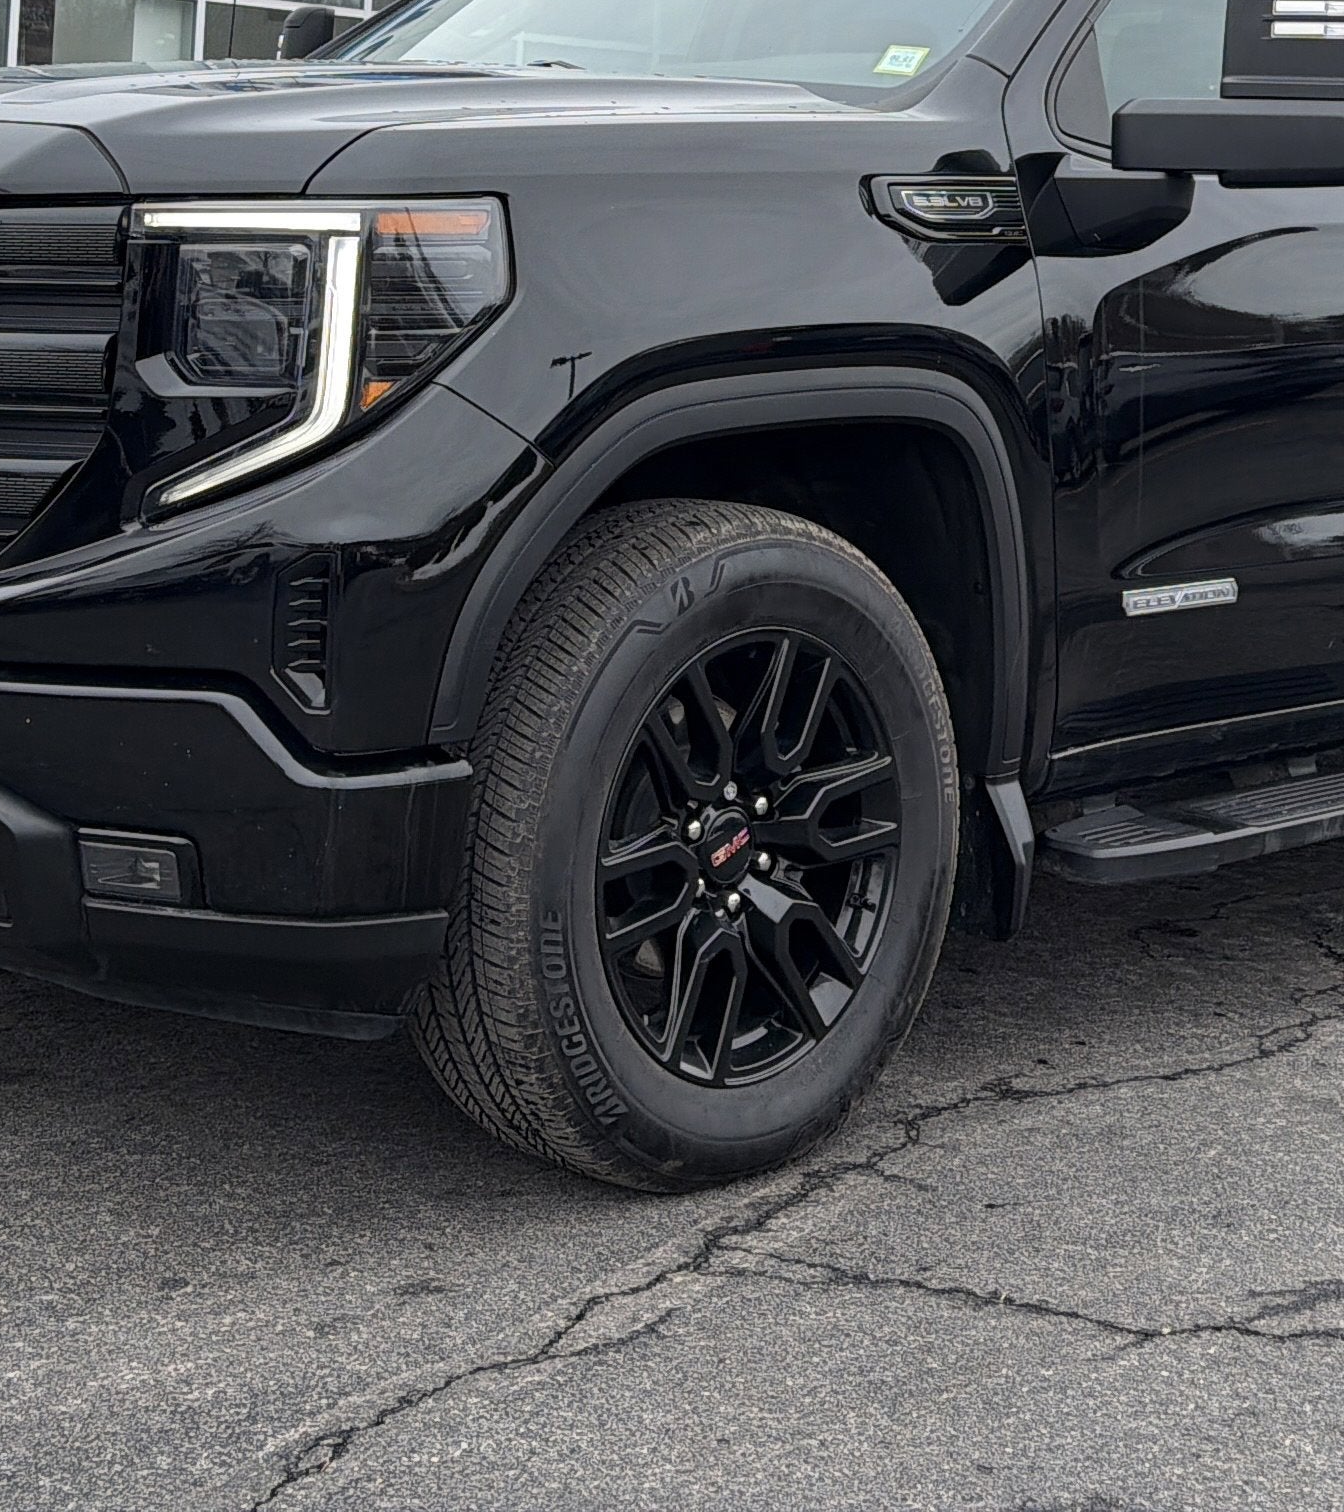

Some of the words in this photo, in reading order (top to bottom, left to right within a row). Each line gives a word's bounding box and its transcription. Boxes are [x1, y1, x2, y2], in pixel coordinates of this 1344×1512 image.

[1132, 586, 1232, 609] ELEVATION
[711, 827, 751, 867] GMC
[540, 910, 629, 1126] BRIDGESTONE
